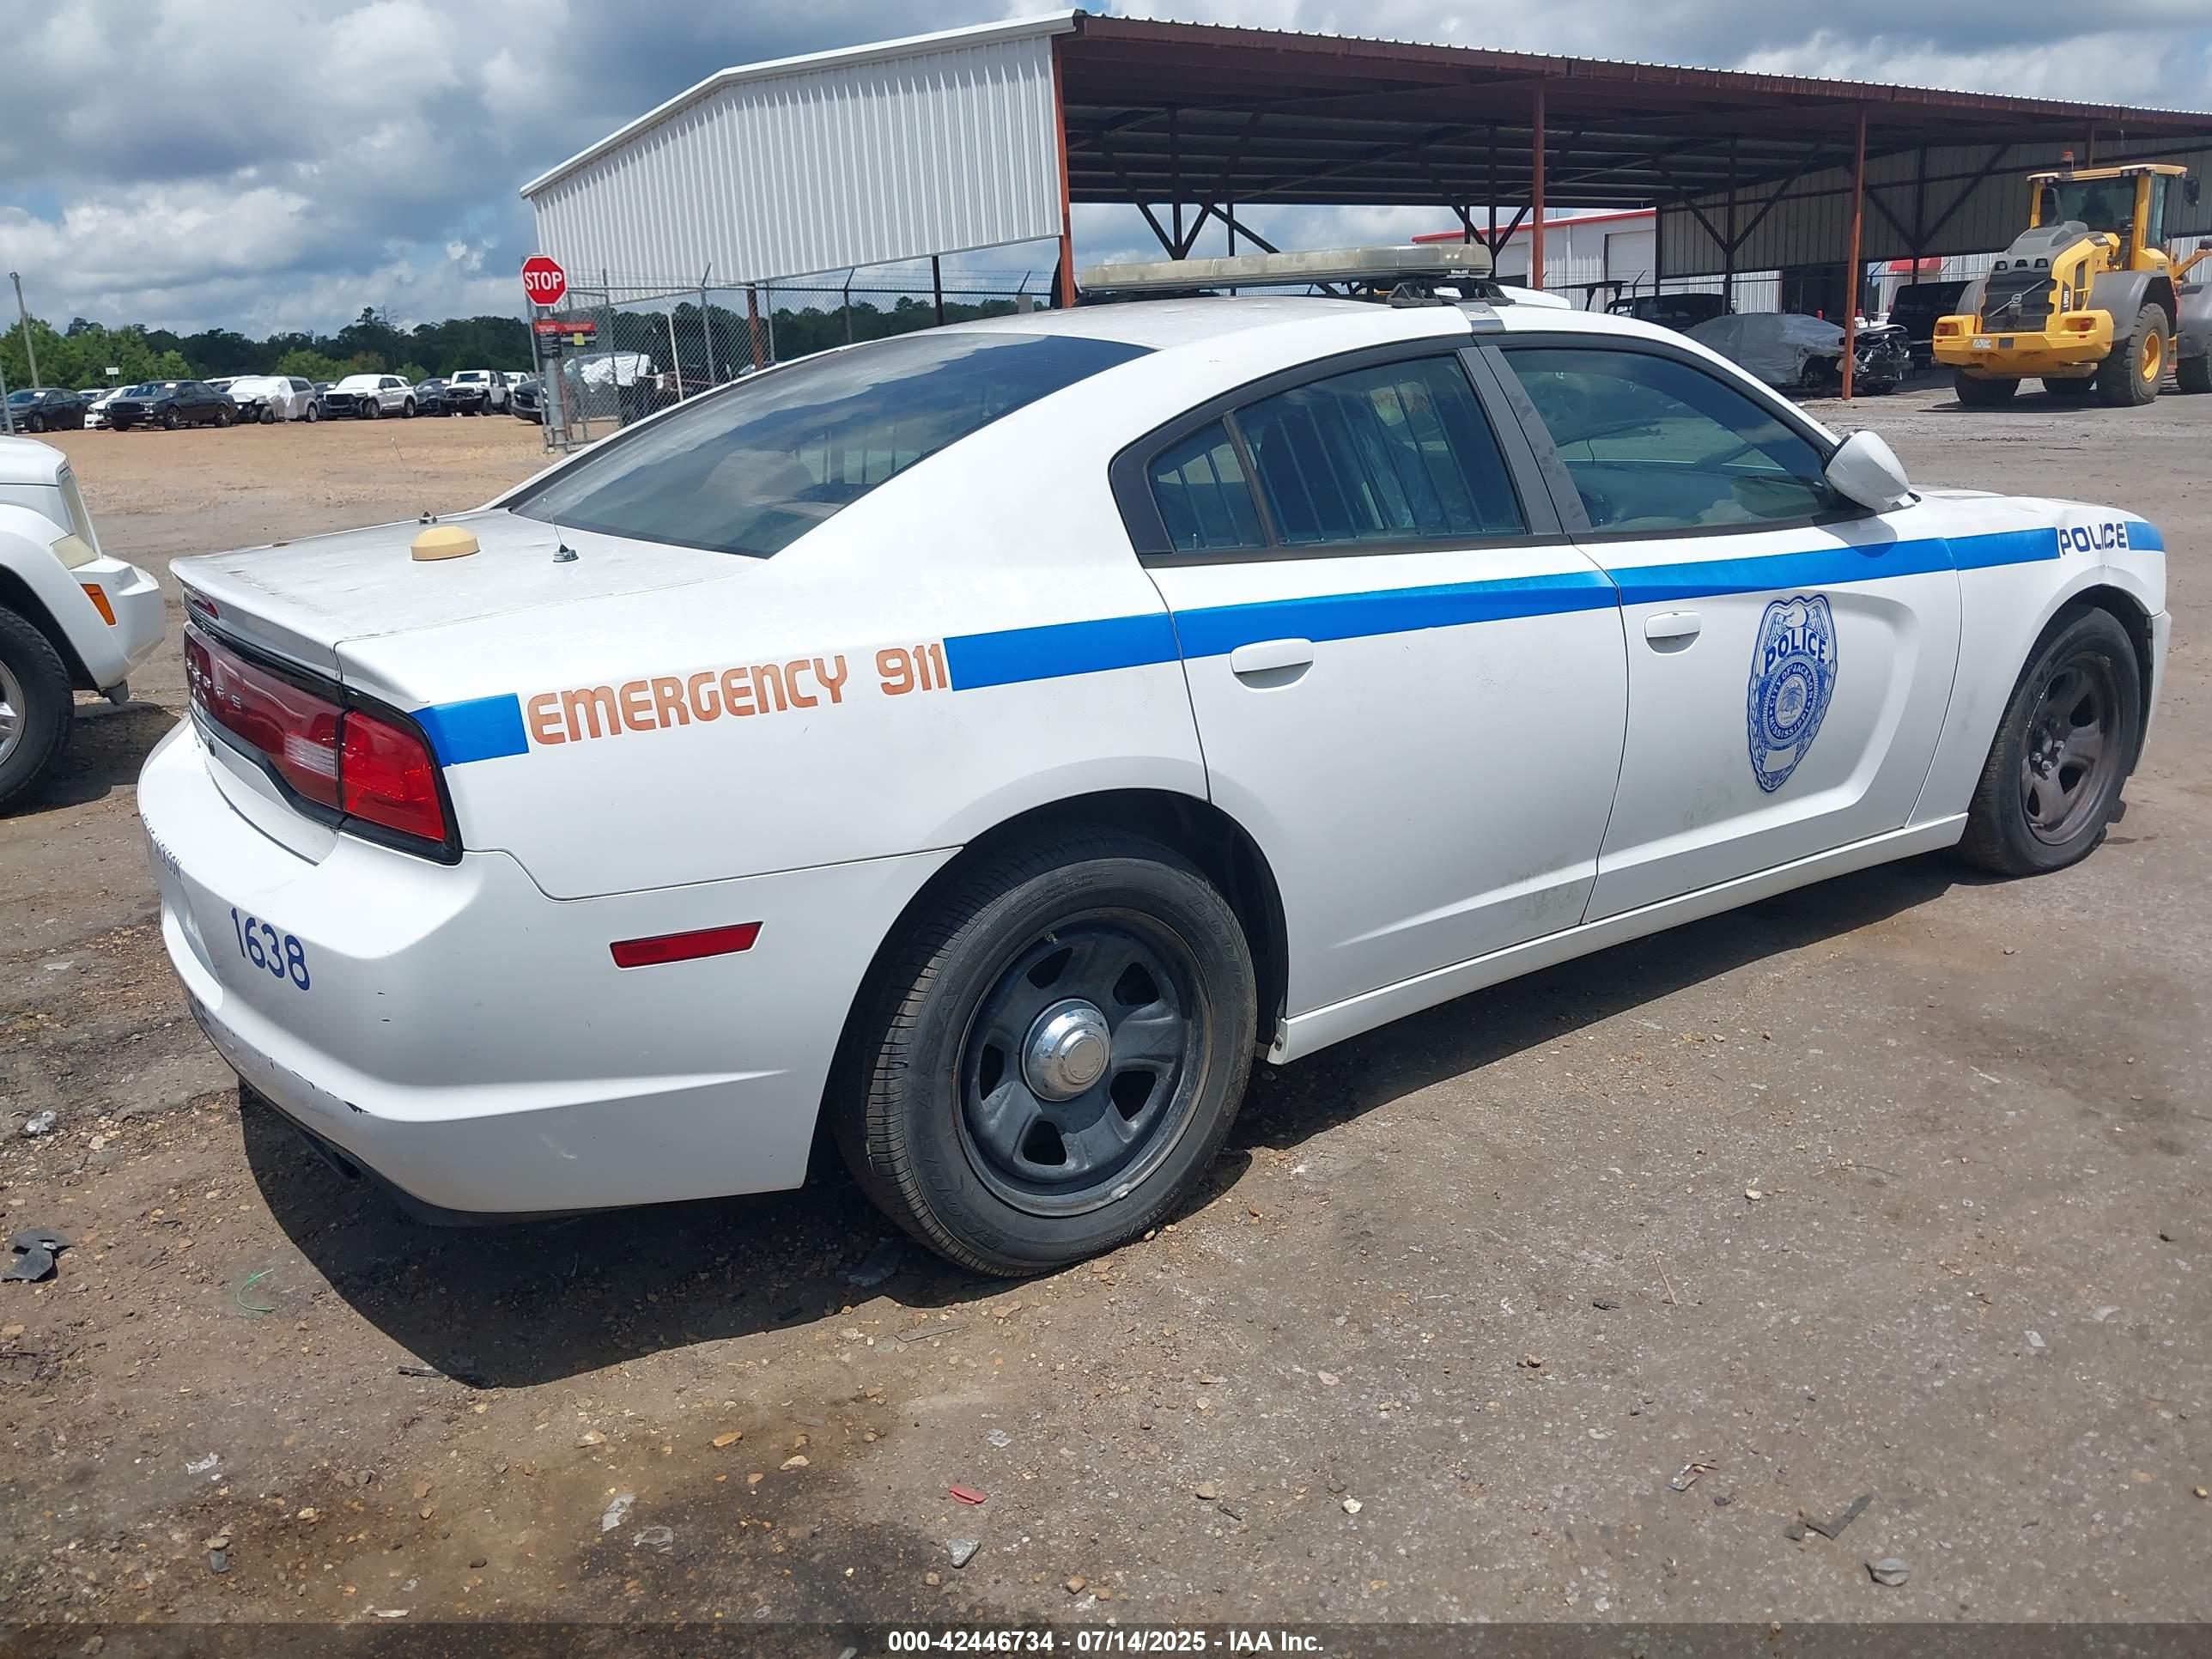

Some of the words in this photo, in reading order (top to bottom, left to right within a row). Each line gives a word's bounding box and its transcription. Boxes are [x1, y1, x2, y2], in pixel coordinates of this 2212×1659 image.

[525, 271, 562, 290] STOP
[2059, 523, 2127, 556] POLICE
[1765, 627, 1826, 675] POLICE
[527, 655, 848, 744] EMERGENCY
[876, 643, 947, 696] 911
[1770, 680, 1782, 708] CITY
[1782, 665, 1793, 680] OF
[1792, 664, 1814, 700] JACKSON
[1768, 709, 1809, 738] MISSISSIPPI
[230, 907, 310, 991] 1638
